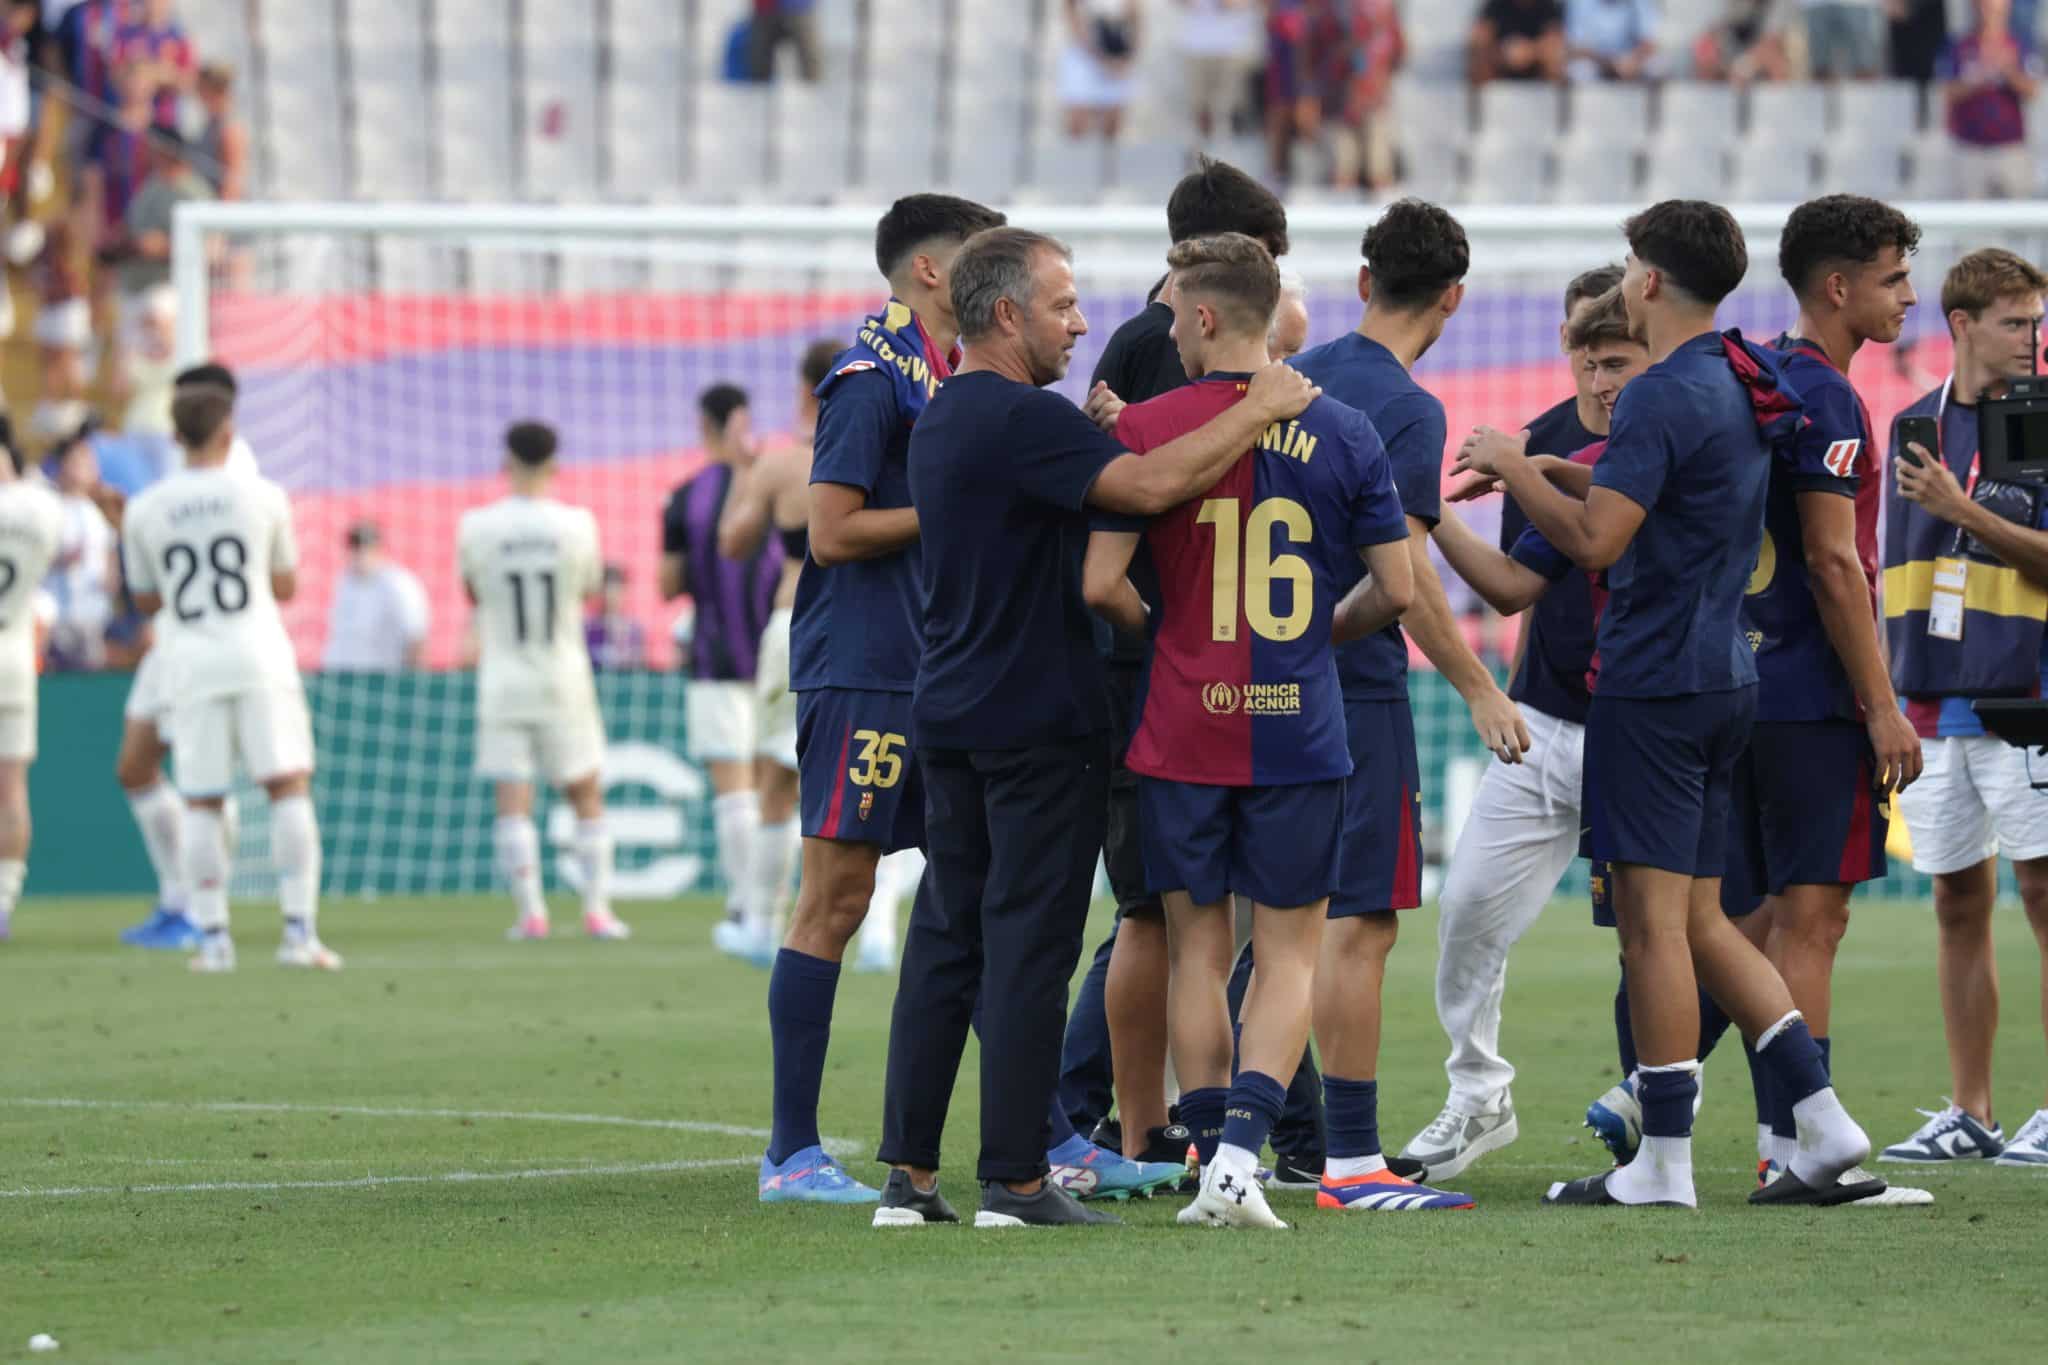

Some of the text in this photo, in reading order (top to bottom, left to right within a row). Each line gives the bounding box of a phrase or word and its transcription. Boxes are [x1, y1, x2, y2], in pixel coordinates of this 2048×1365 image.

[1257, 419, 1318, 464] MÍN
[163, 535, 249, 622] 28
[1195, 496, 1314, 642] 16
[507, 570, 556, 644] 11
[1243, 683, 1300, 697] UNHCR
[1243, 697, 1301, 710] ACNUR
[849, 729, 906, 788] 35
